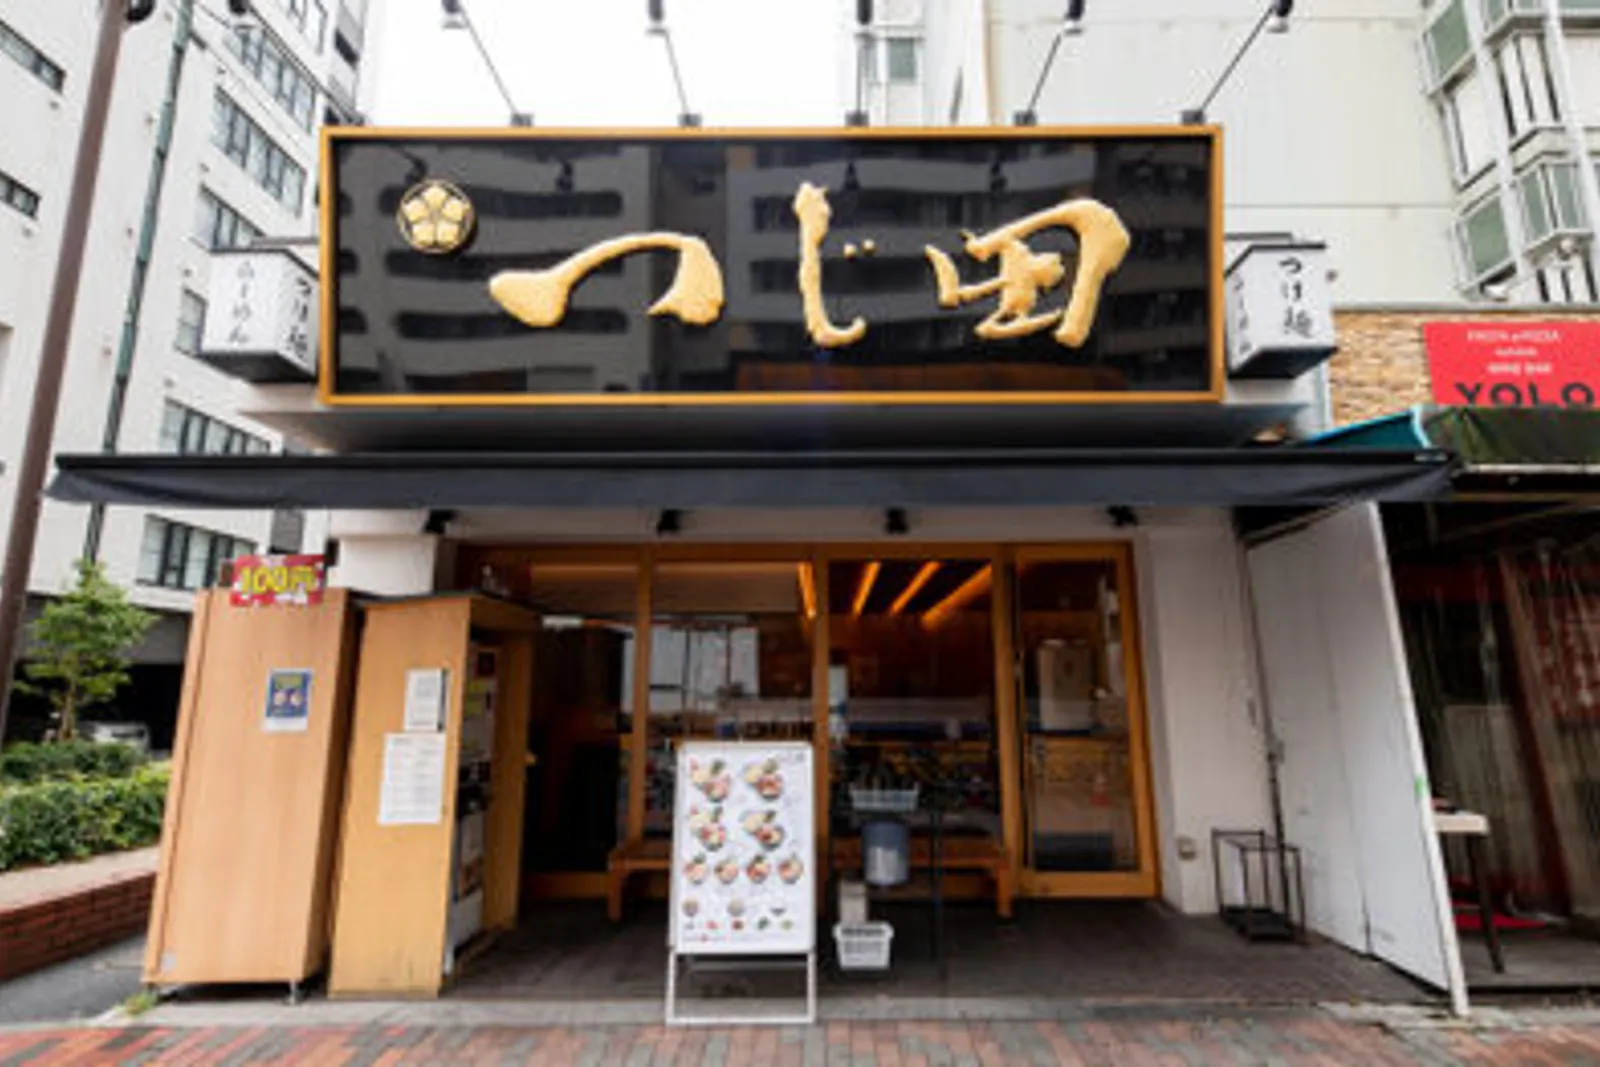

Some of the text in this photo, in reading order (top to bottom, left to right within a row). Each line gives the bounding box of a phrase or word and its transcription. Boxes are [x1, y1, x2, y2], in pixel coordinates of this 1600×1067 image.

[488, 181, 1131, 349] つじ田
[1277, 256, 1314, 339] つけ麺
